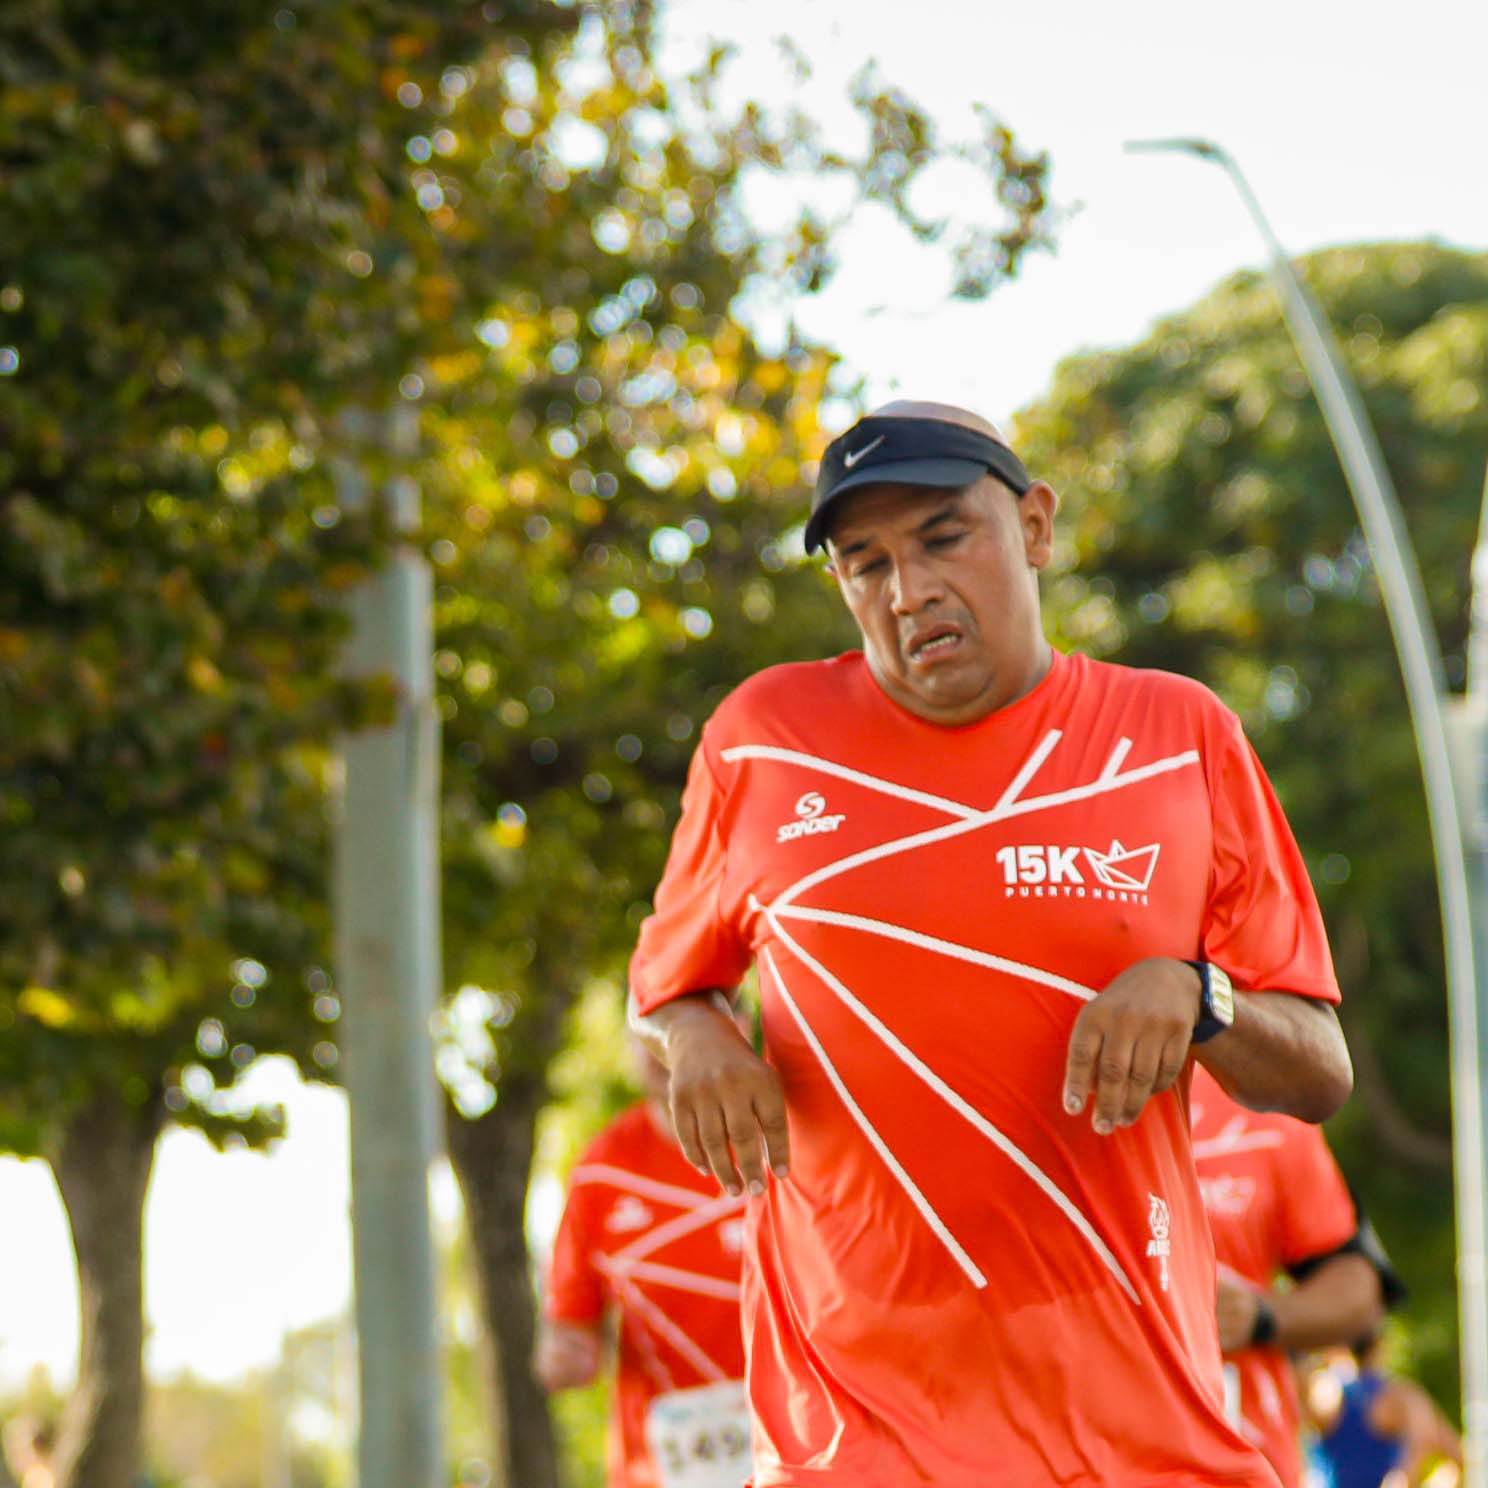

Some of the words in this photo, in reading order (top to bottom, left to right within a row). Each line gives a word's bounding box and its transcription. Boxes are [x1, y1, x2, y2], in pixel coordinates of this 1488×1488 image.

[995, 845, 1085, 884] 15K
[1005, 885, 1086, 898] PUERTO
[1092, 888, 1149, 905] NORTE
